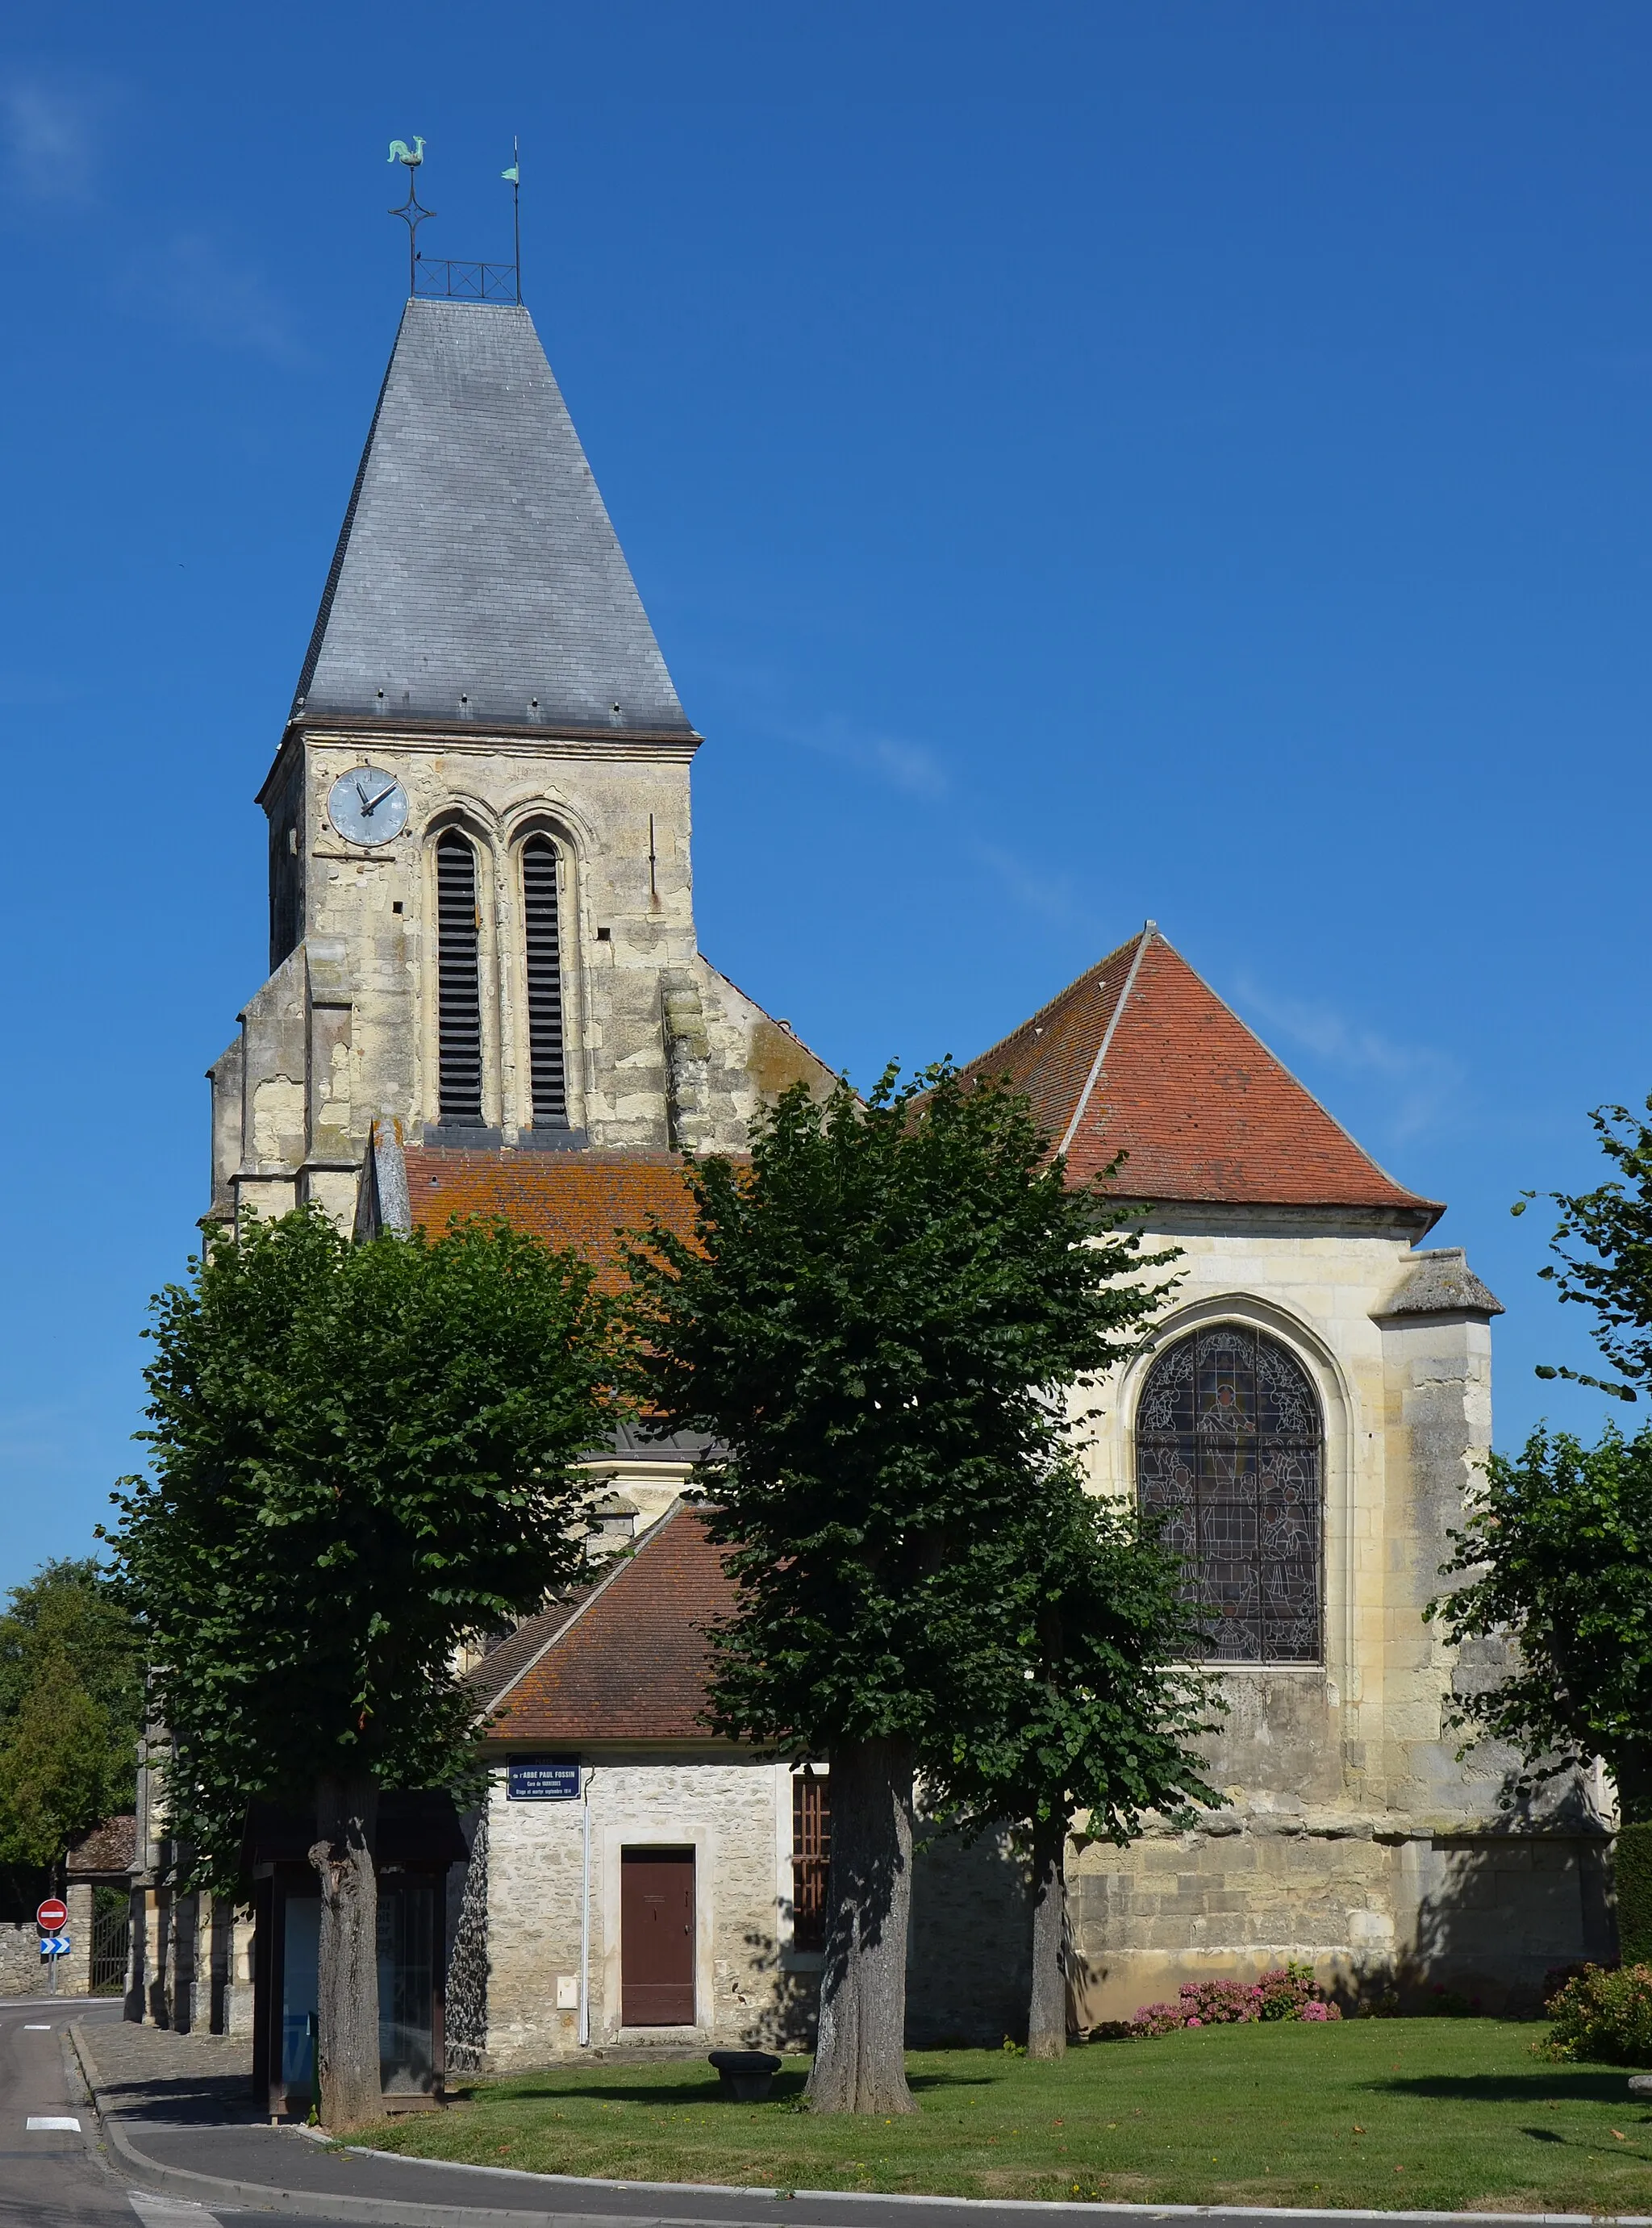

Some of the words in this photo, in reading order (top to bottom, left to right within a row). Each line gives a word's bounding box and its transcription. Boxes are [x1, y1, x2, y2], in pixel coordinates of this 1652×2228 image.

[377, 1900, 390, 1909] au
[377, 1911, 391, 1922] oit
[378, 1926, 390, 1934] er
